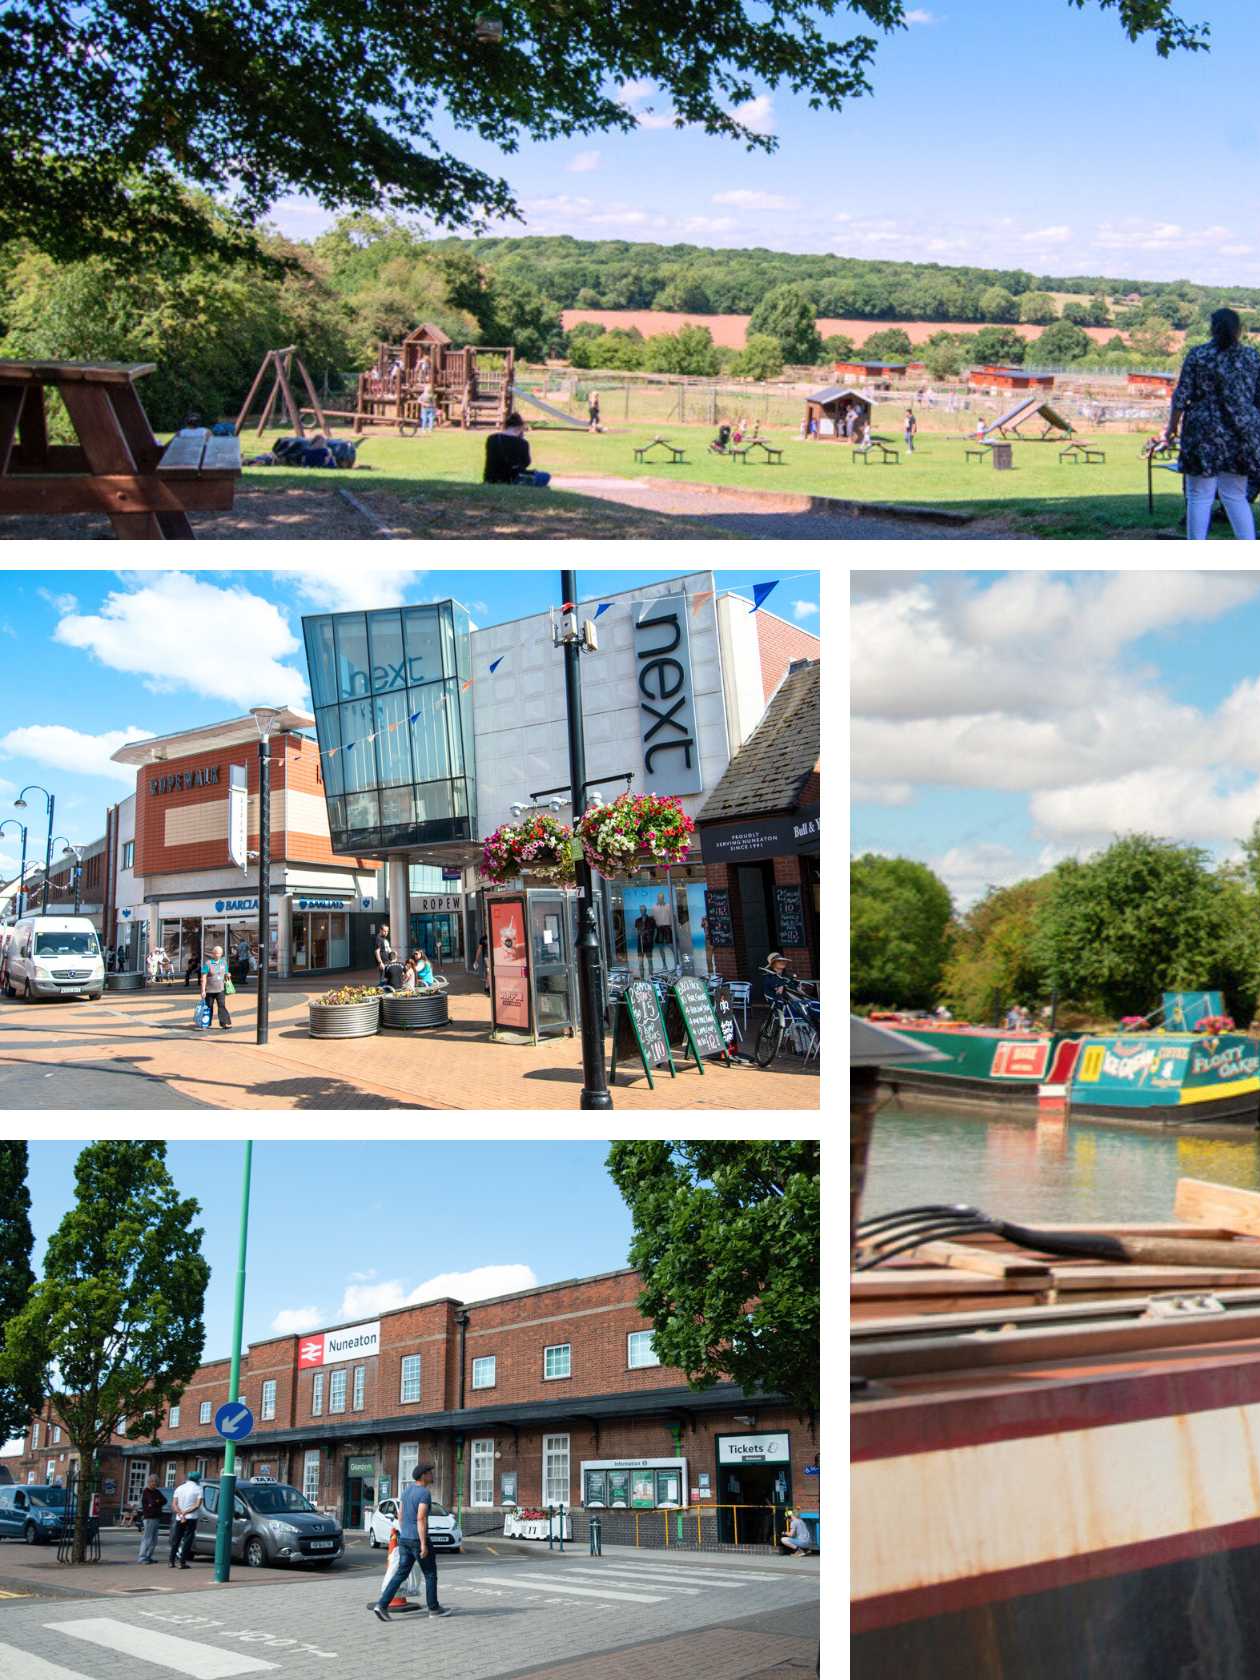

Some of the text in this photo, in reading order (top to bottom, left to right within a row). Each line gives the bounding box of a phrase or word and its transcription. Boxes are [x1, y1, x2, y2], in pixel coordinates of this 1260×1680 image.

[636, 613, 694, 774] next
[731, 831, 760, 840] PROUDLY
[793, 823, 808, 838] Bull
[716, 835, 778, 848] SERVING NUNEATON
[730, 844, 748, 852] SINCE
[226, 899, 259, 911] BARCLA
[423, 898, 460, 910] ROPEW
[329, 1334, 377, 1352] Nuneaton
[728, 1444, 764, 1454] Tickets
